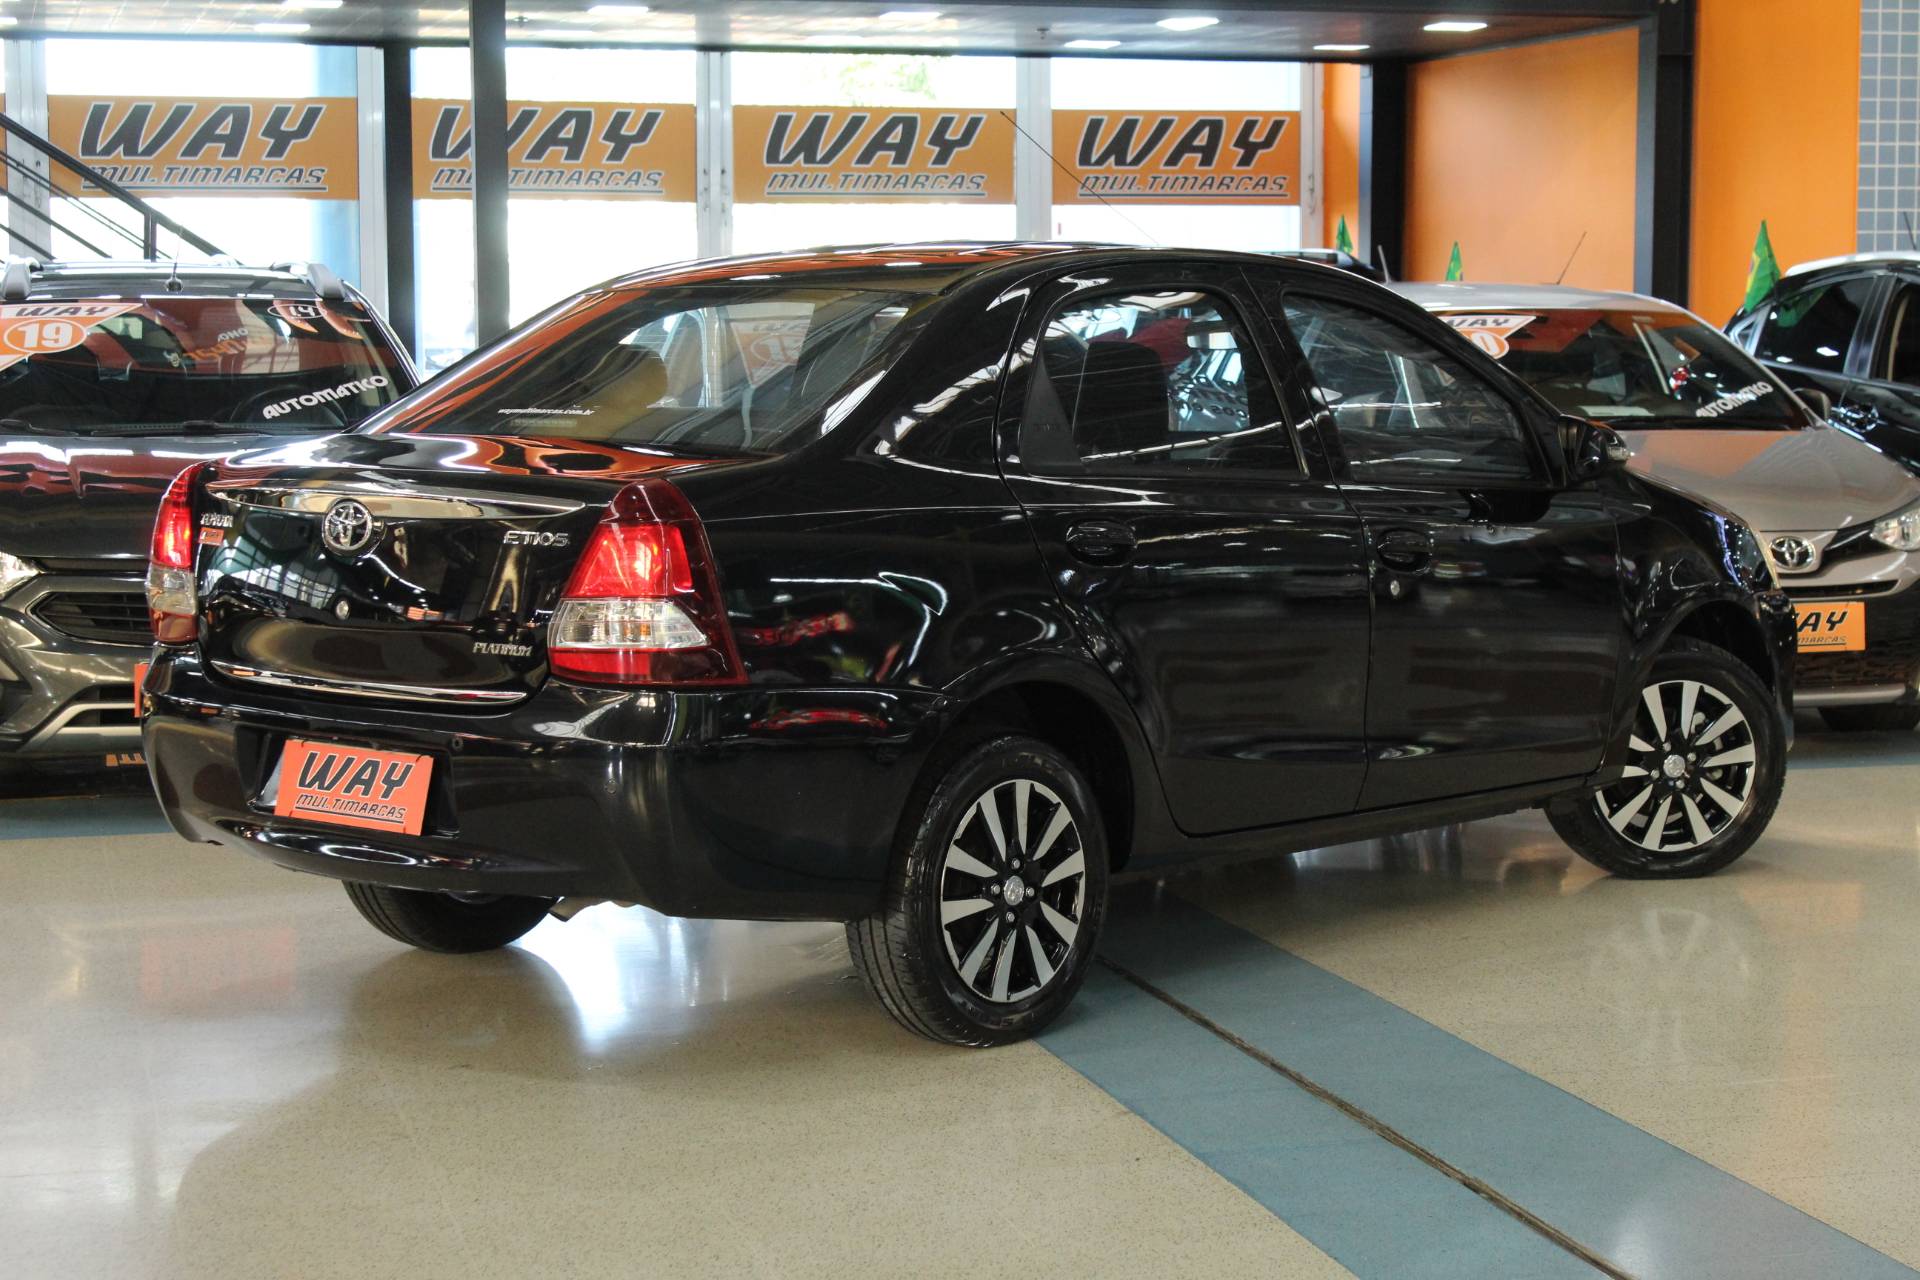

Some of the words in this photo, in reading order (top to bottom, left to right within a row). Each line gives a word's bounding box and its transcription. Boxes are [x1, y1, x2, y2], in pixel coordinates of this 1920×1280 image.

[79, 102, 328, 160] WAY
[764, 112, 987, 167] WAY
[1077, 115, 1289, 170] WAY
[431, 167, 664, 186] MTIMARCAS
[767, 172, 986, 190] MULTIMARCAS
[1080, 174, 1288, 192] MULTIMARCAS
[15, 306, 110, 317] WAY
[17, 322, 73, 349] 19
[262, 375, 389, 420] AUTOMATICO
[503, 530, 570, 547] ETIOS
[1796, 610, 1848, 633] AY
[472, 641, 534, 657] PLATINUM
[296, 751, 416, 800] WAY
[296, 793, 408, 820] MULTIMARCAS
